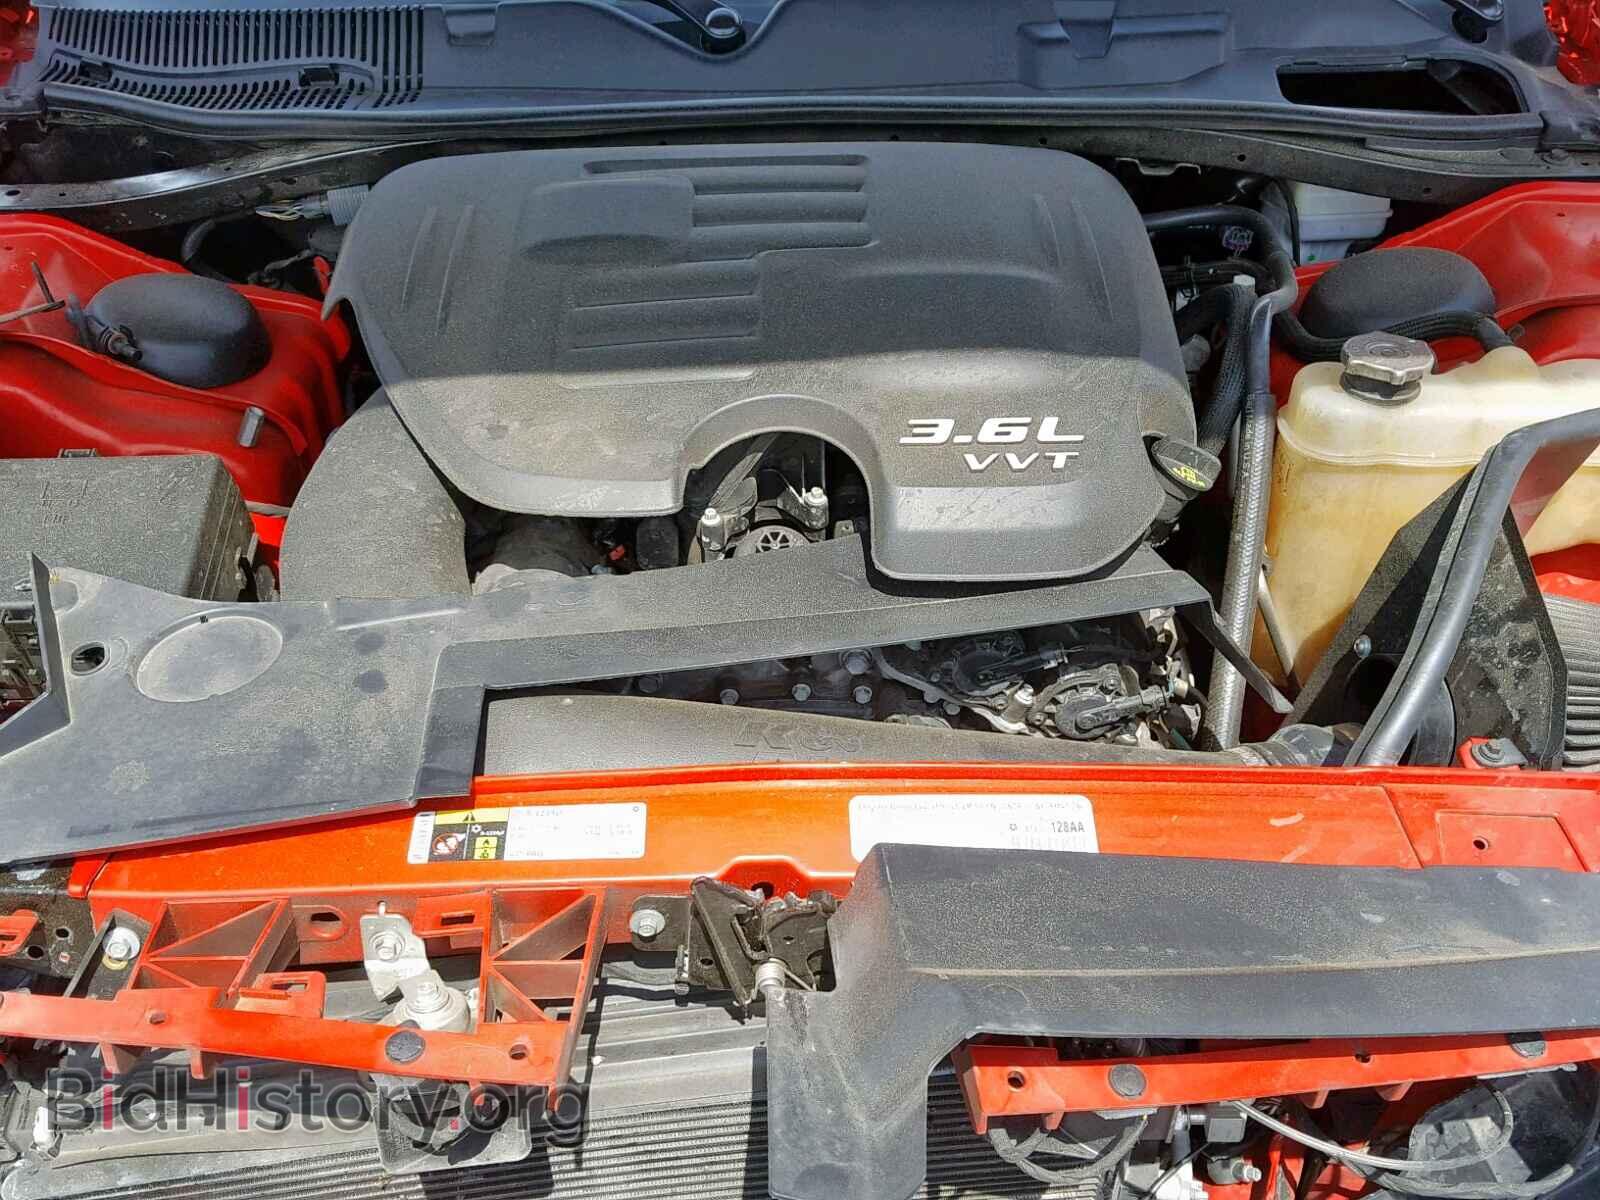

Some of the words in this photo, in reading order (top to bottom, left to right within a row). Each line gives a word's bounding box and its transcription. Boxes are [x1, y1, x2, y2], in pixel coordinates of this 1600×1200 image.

[898, 416, 1085, 445] 3.6L
[963, 452, 1080, 472] VVT
[1051, 821, 1085, 833] 128AA
